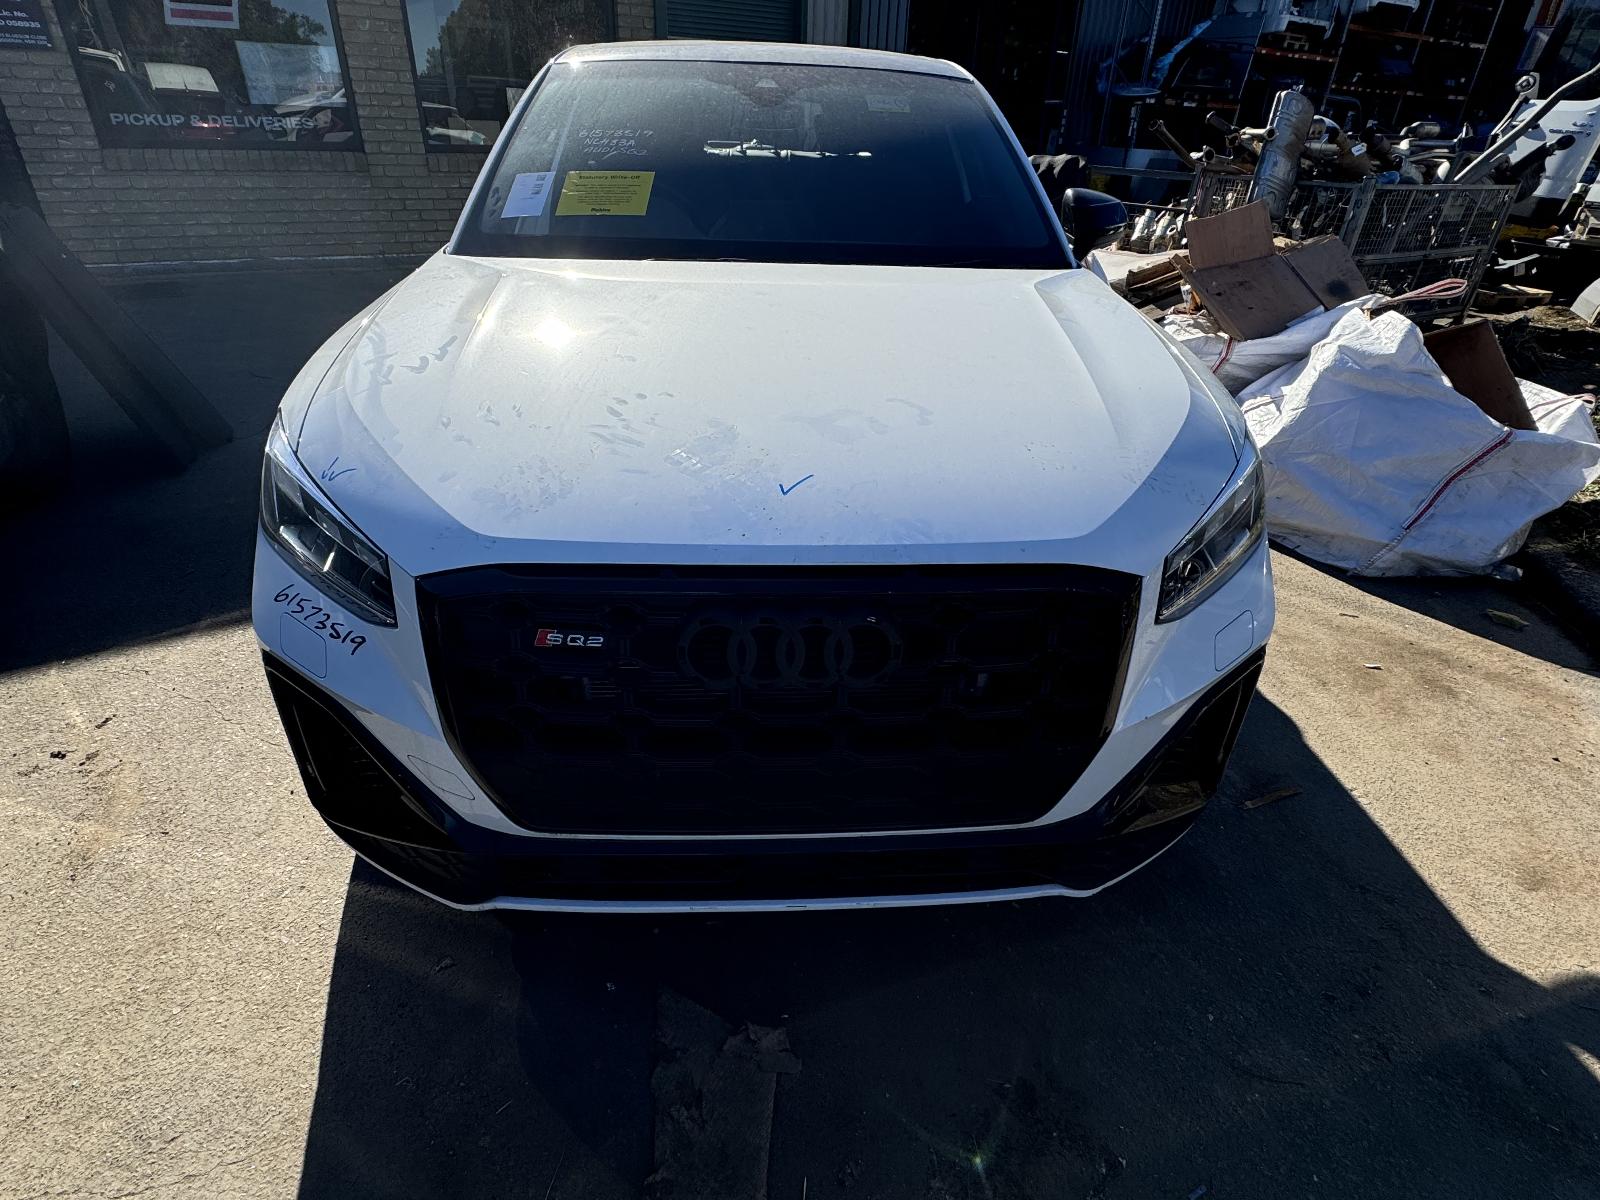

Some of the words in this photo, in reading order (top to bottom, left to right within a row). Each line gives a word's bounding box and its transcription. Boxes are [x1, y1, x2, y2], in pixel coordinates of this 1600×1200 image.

[110, 112, 185, 127] PICKUP
[190, 114, 203, 127] &
[207, 114, 315, 130] DELIVERIES
[273, 583, 367, 656] 61573519
[546, 633, 604, 647] SQ2
